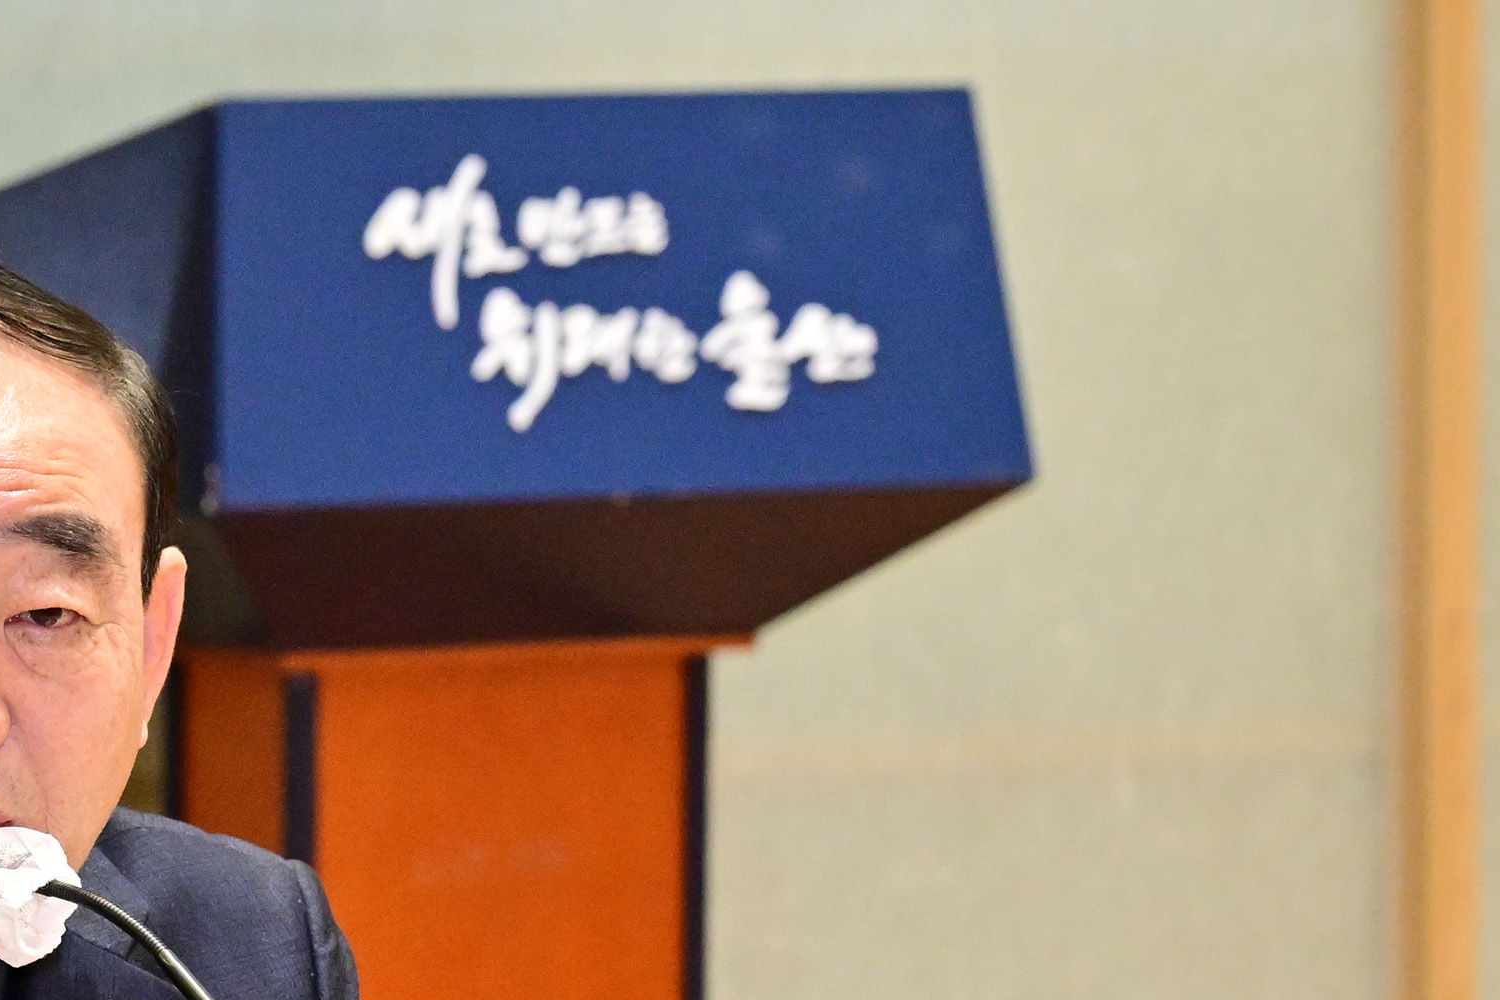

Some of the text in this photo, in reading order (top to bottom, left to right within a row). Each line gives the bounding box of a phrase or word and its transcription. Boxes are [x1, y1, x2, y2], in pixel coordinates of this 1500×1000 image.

[363, 153, 670, 331] 새로 만드는
[469, 270, 879, 433] 위대한 울산
